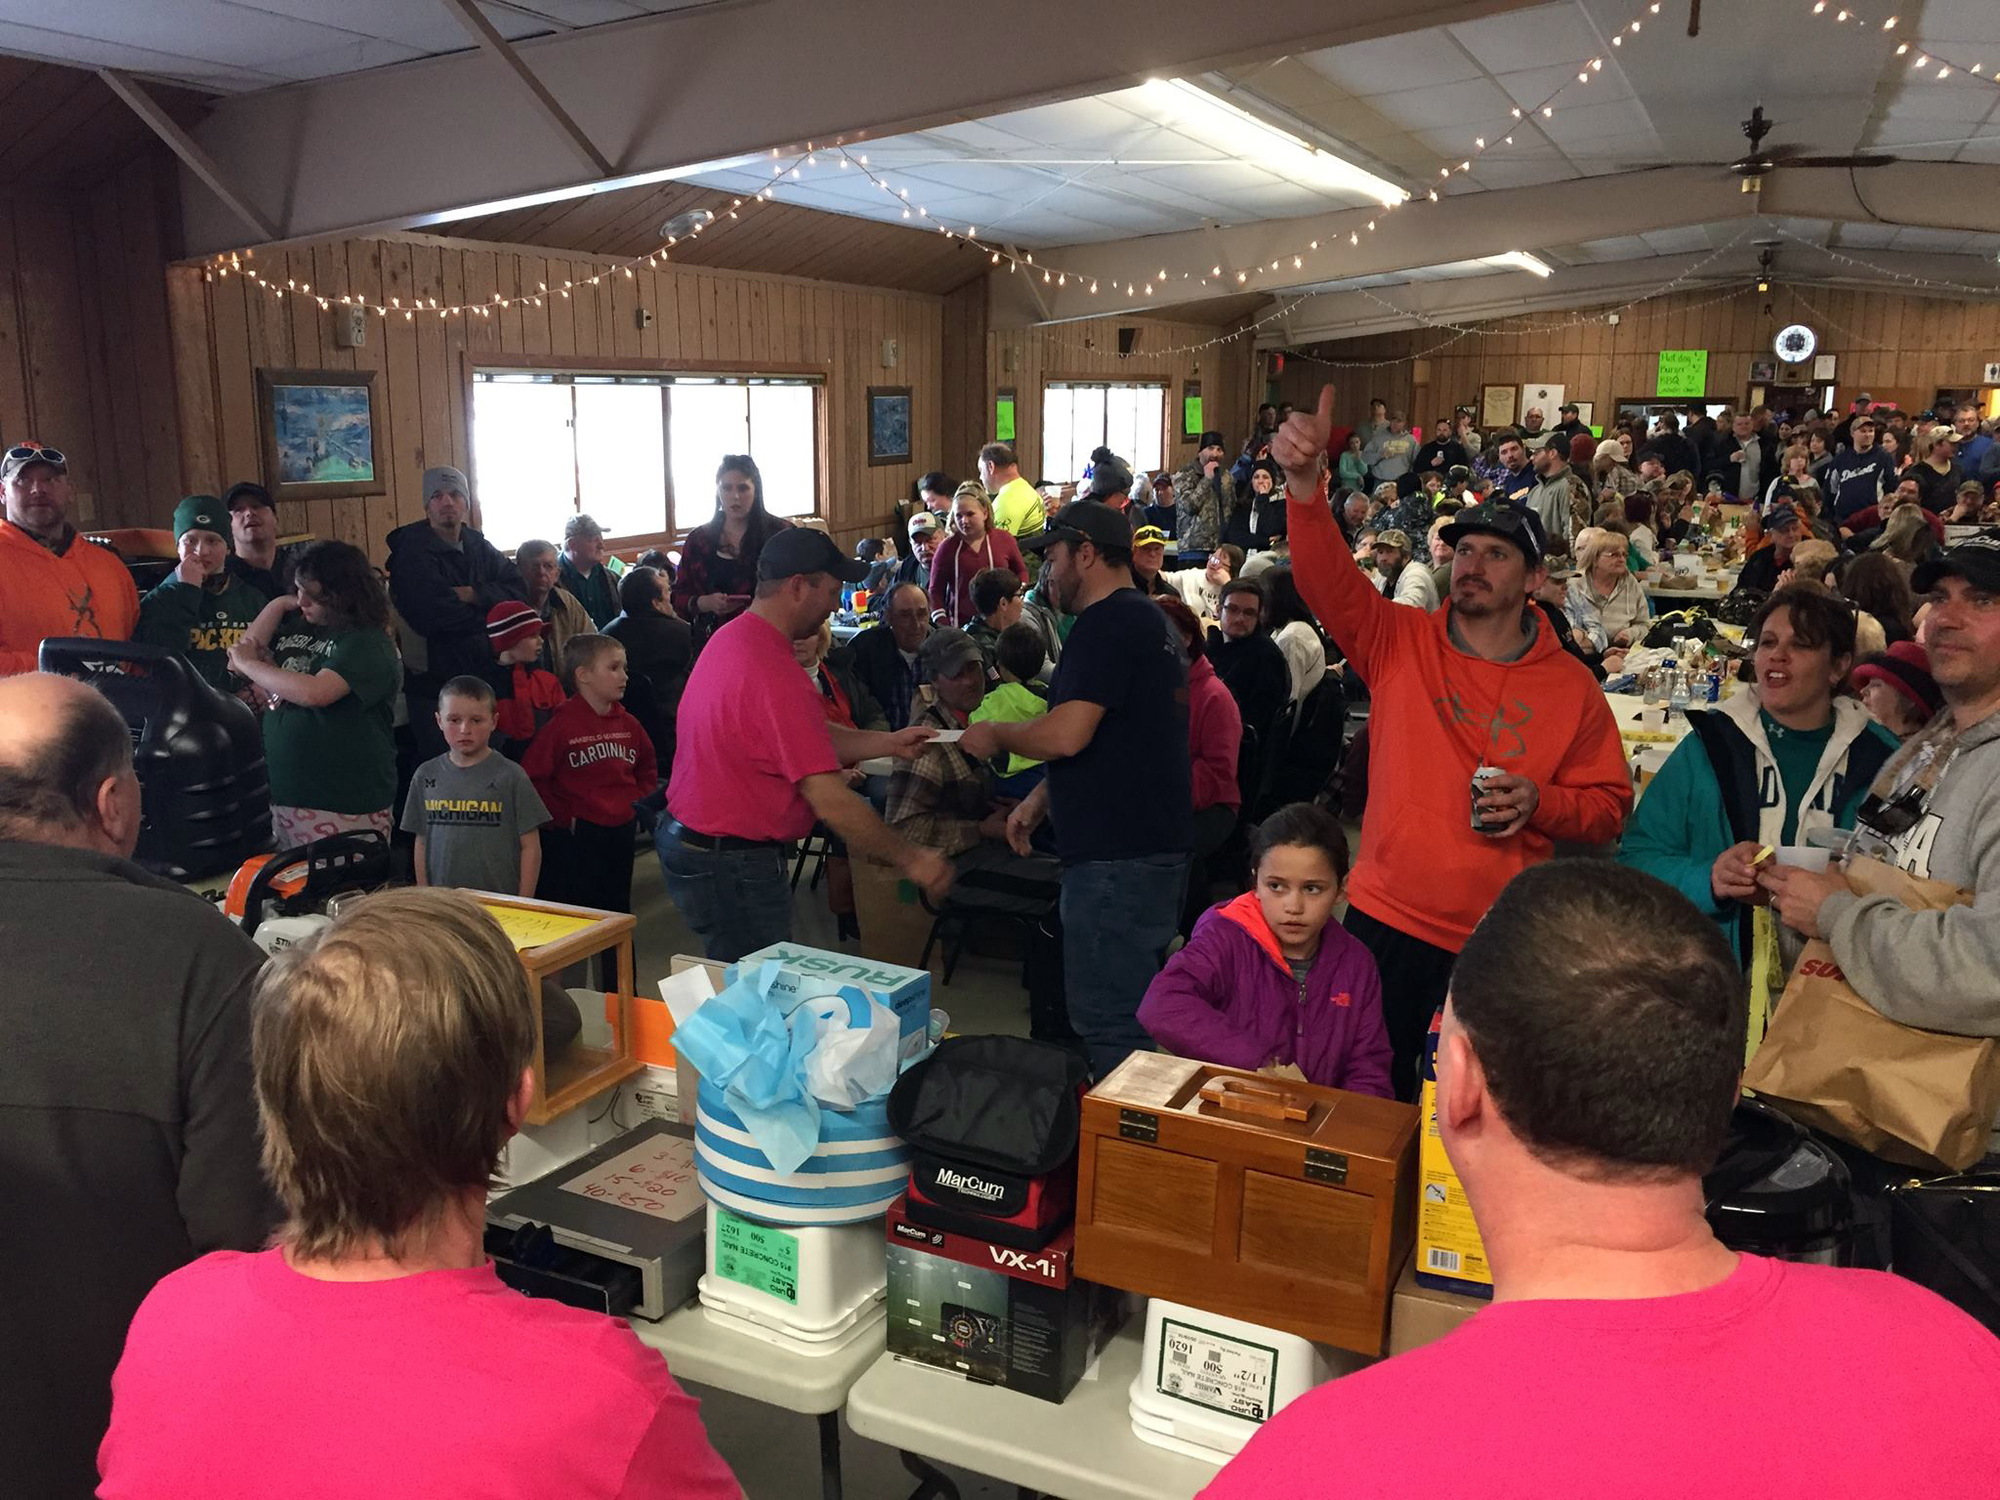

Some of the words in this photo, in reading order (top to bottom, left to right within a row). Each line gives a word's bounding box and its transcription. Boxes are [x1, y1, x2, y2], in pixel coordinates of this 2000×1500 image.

[568, 742, 636, 768] CARDINALS
[424, 800, 502, 821] MICHIGAN
[765, 949, 907, 987] RUSK
[936, 1167, 1005, 1199] MarCum
[750, 1231, 765, 1244] 500
[896, 1224, 927, 1239] MarCum
[721, 1240, 739, 1252] NAIL
[740, 1245, 779, 1267] CONCRETE
[1168, 1339, 1194, 1354] 1620
[1180, 1369, 1195, 1378] NAIL
[1203, 1360, 1224, 1374] 500
[1197, 1374, 1233, 1391] CONCRETE
